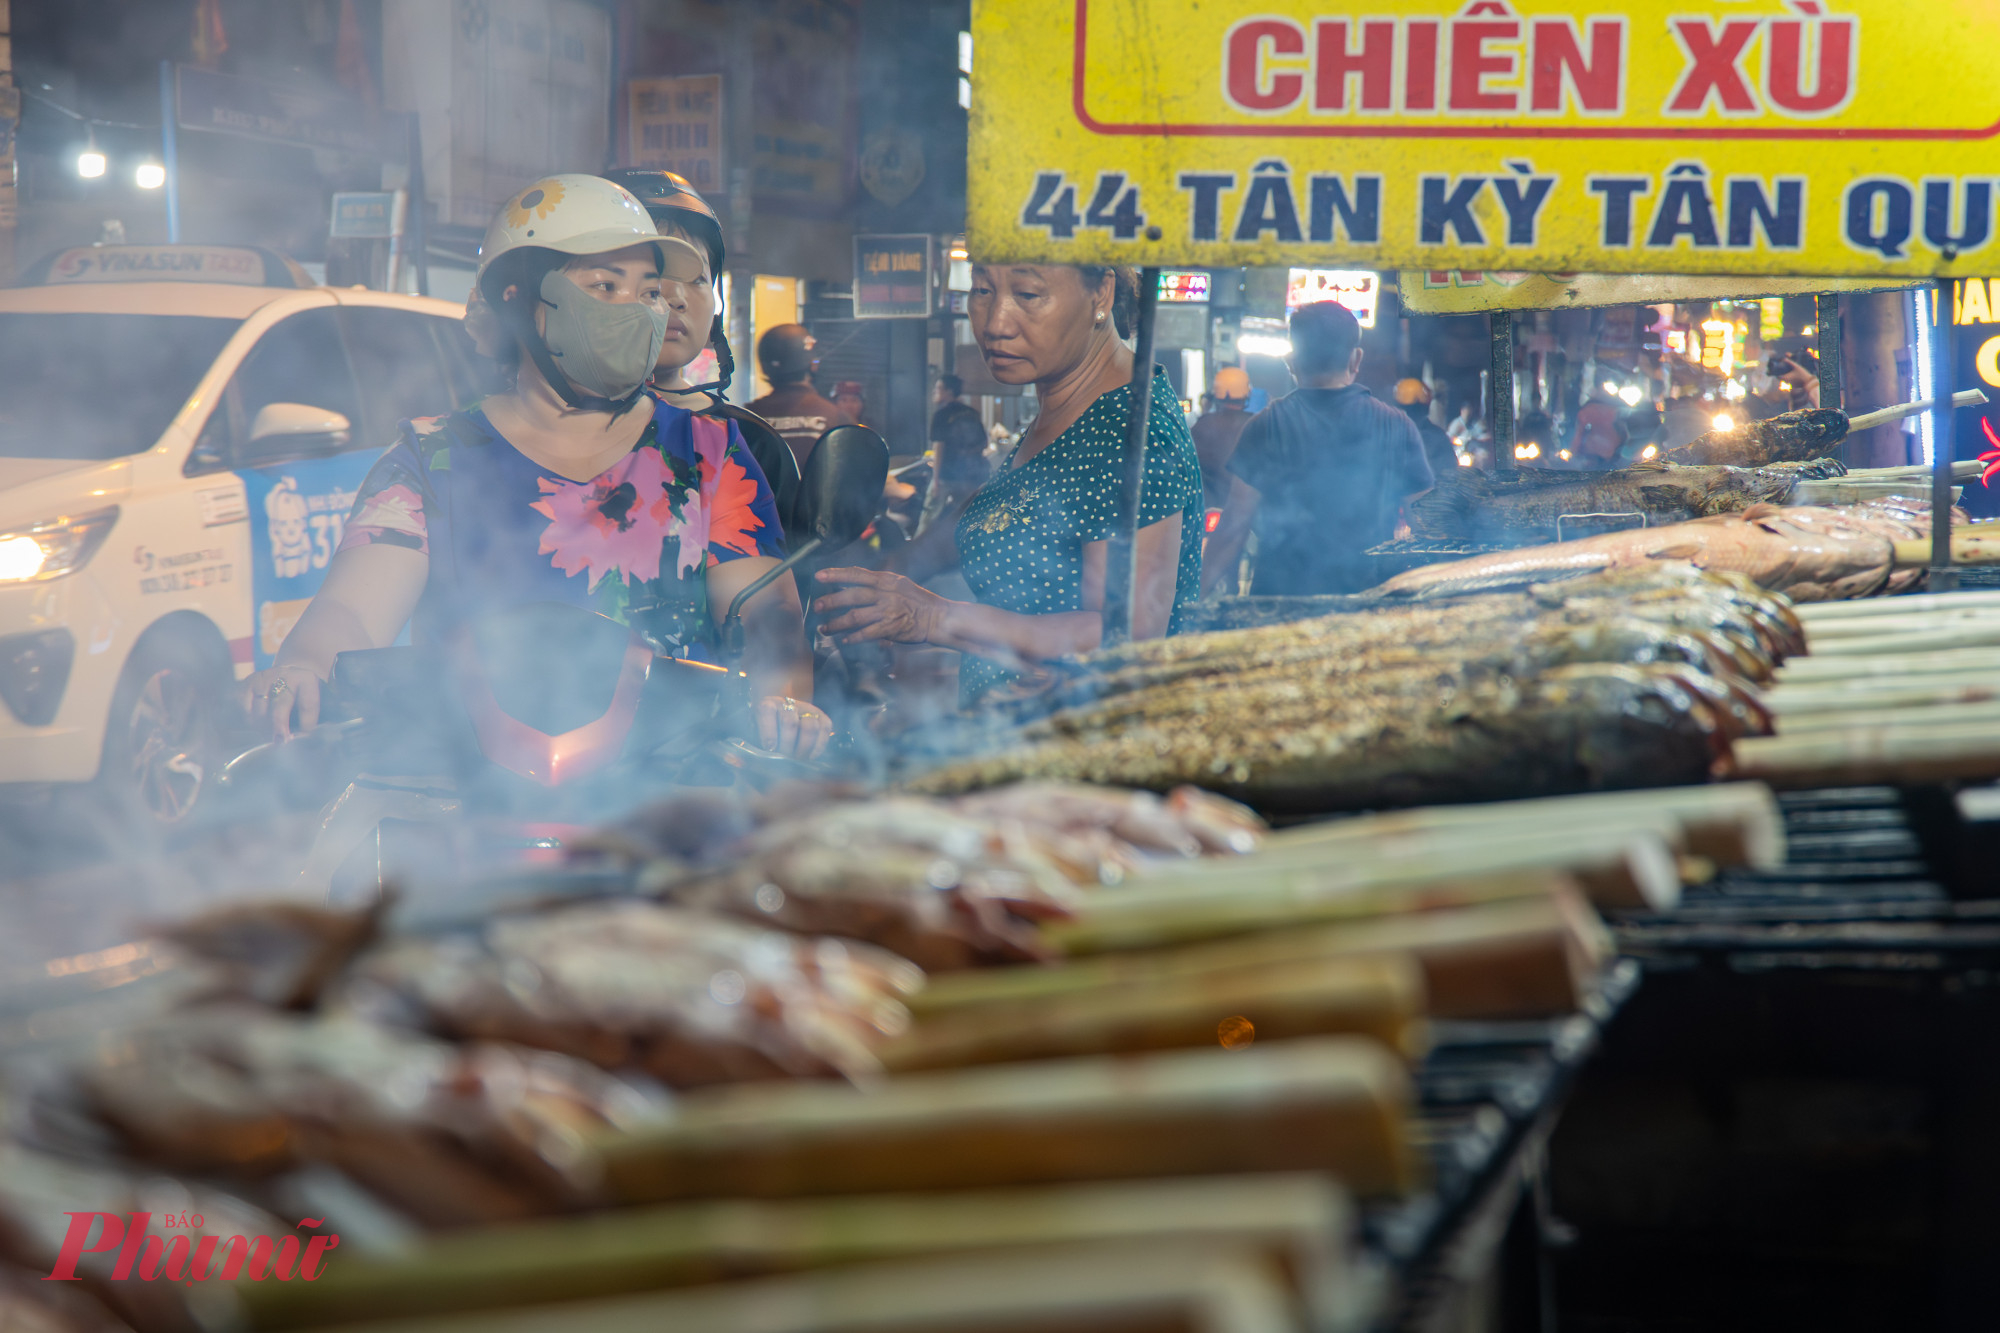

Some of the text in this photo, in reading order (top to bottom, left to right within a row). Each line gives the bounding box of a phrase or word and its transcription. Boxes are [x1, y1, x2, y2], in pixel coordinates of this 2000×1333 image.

[1225, 0, 1854, 112] CHIÊN XÙ
[1178, 158, 1381, 243] TÂN
[1419, 160, 1557, 246] KỲ
[1589, 160, 1804, 248] TÂN
[1845, 178, 2000, 260] QU
